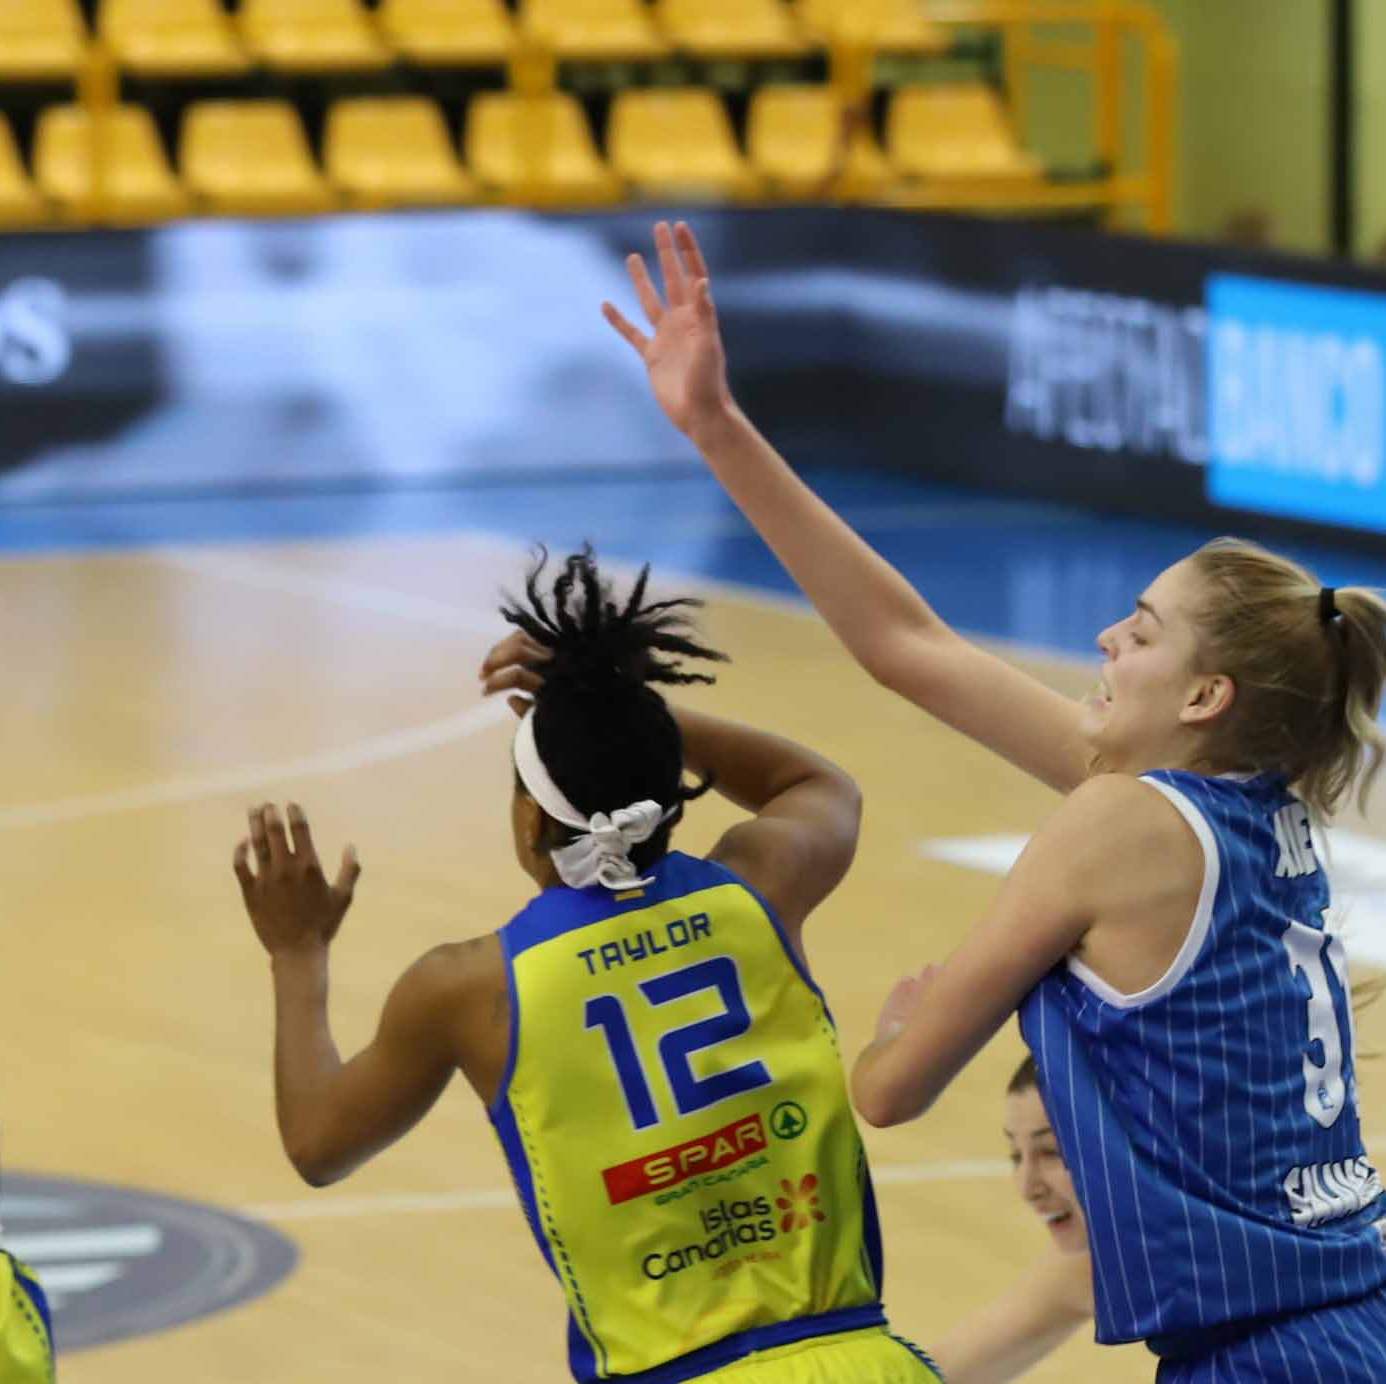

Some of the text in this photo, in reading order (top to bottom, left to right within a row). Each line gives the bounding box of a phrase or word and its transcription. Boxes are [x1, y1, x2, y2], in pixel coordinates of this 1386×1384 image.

[1216, 320, 1383, 486] BANCO
[577, 912, 712, 976] TAYLOR
[585, 957, 772, 1131] 12
[644, 1122, 763, 1186] SPAR
[700, 1196, 771, 1235] Islas
[643, 1219, 776, 1280] Canarias
